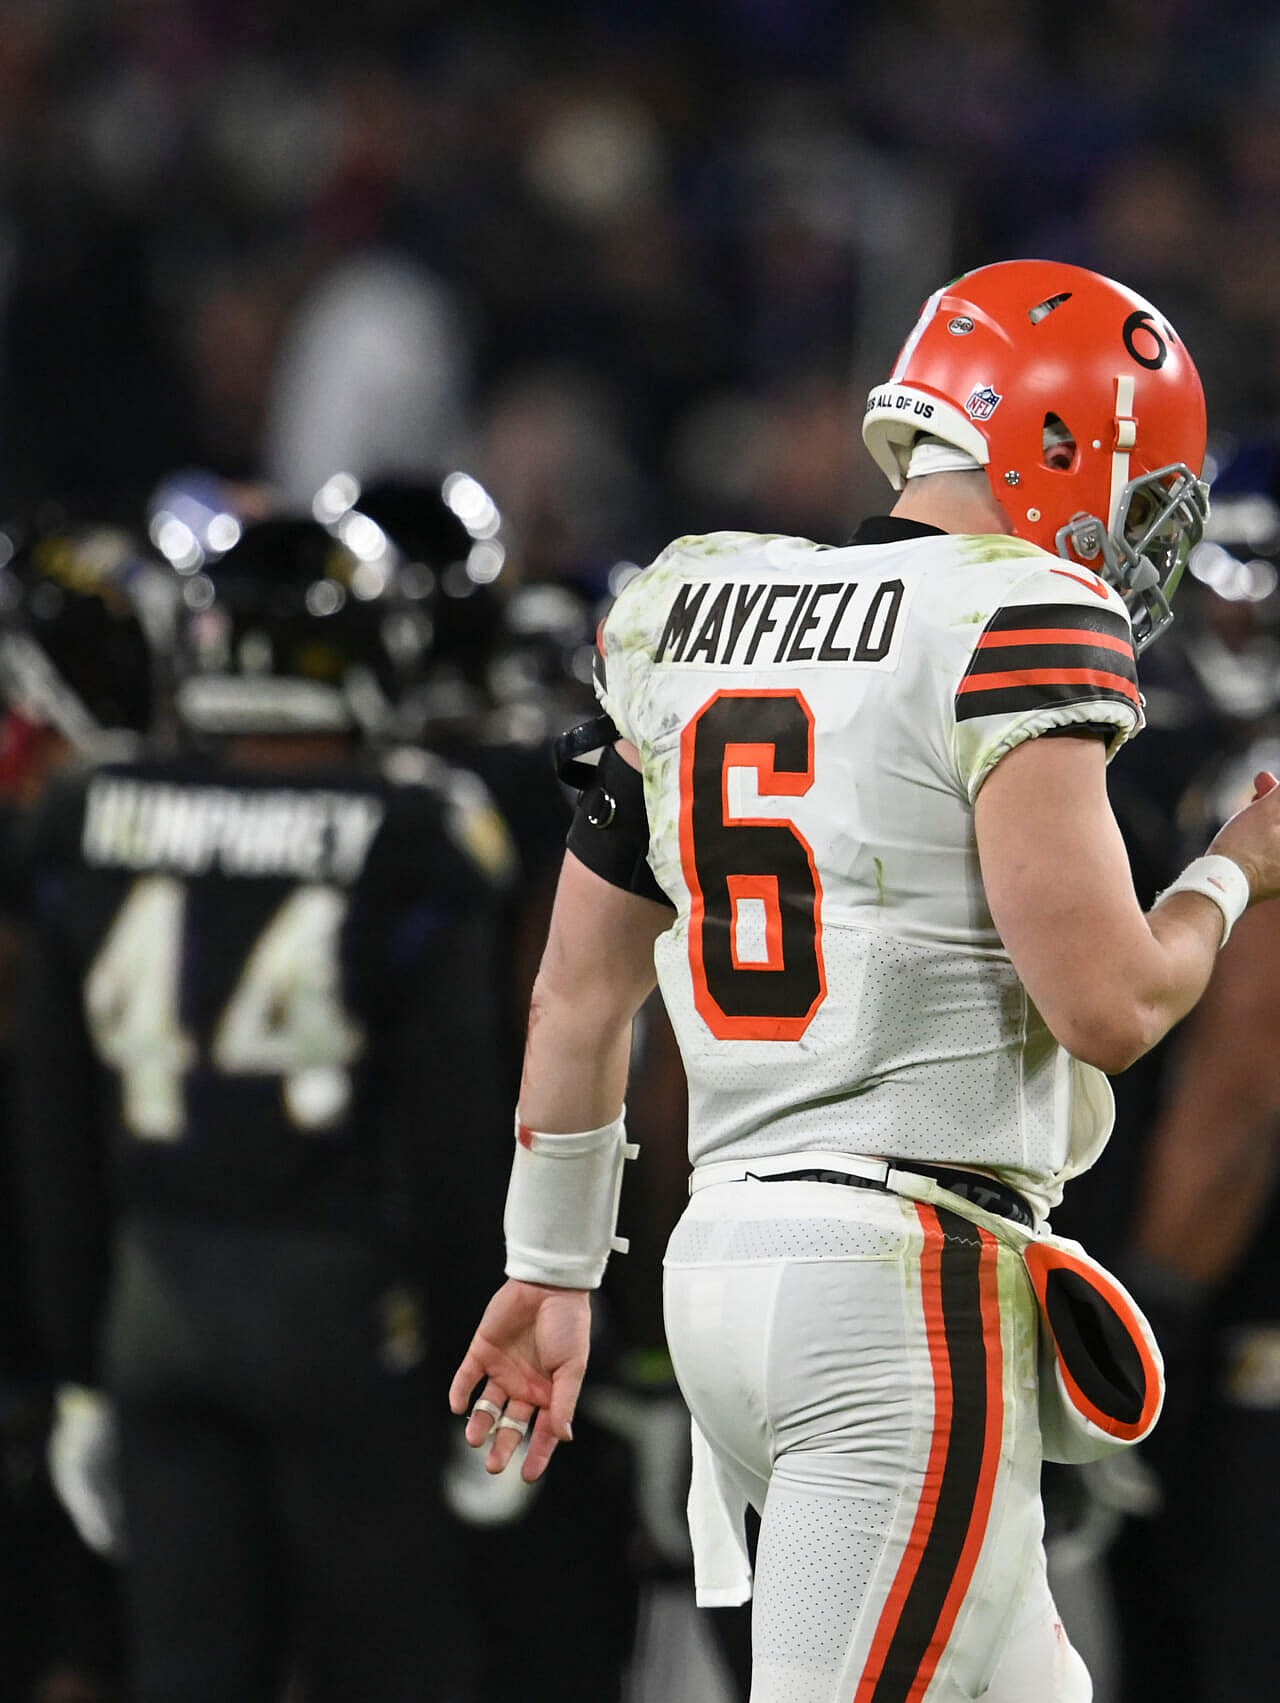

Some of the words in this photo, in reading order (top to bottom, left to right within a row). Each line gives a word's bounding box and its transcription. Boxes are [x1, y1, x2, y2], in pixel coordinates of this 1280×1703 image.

[876, 394, 893, 408] ALL
[896, 395, 913, 410] OF
[914, 401, 935, 419] US
[968, 396, 992, 417] NFL
[653, 578, 905, 665] MAYFIELD
[678, 688, 828, 1041] 6
[84, 872, 364, 1142] 44
